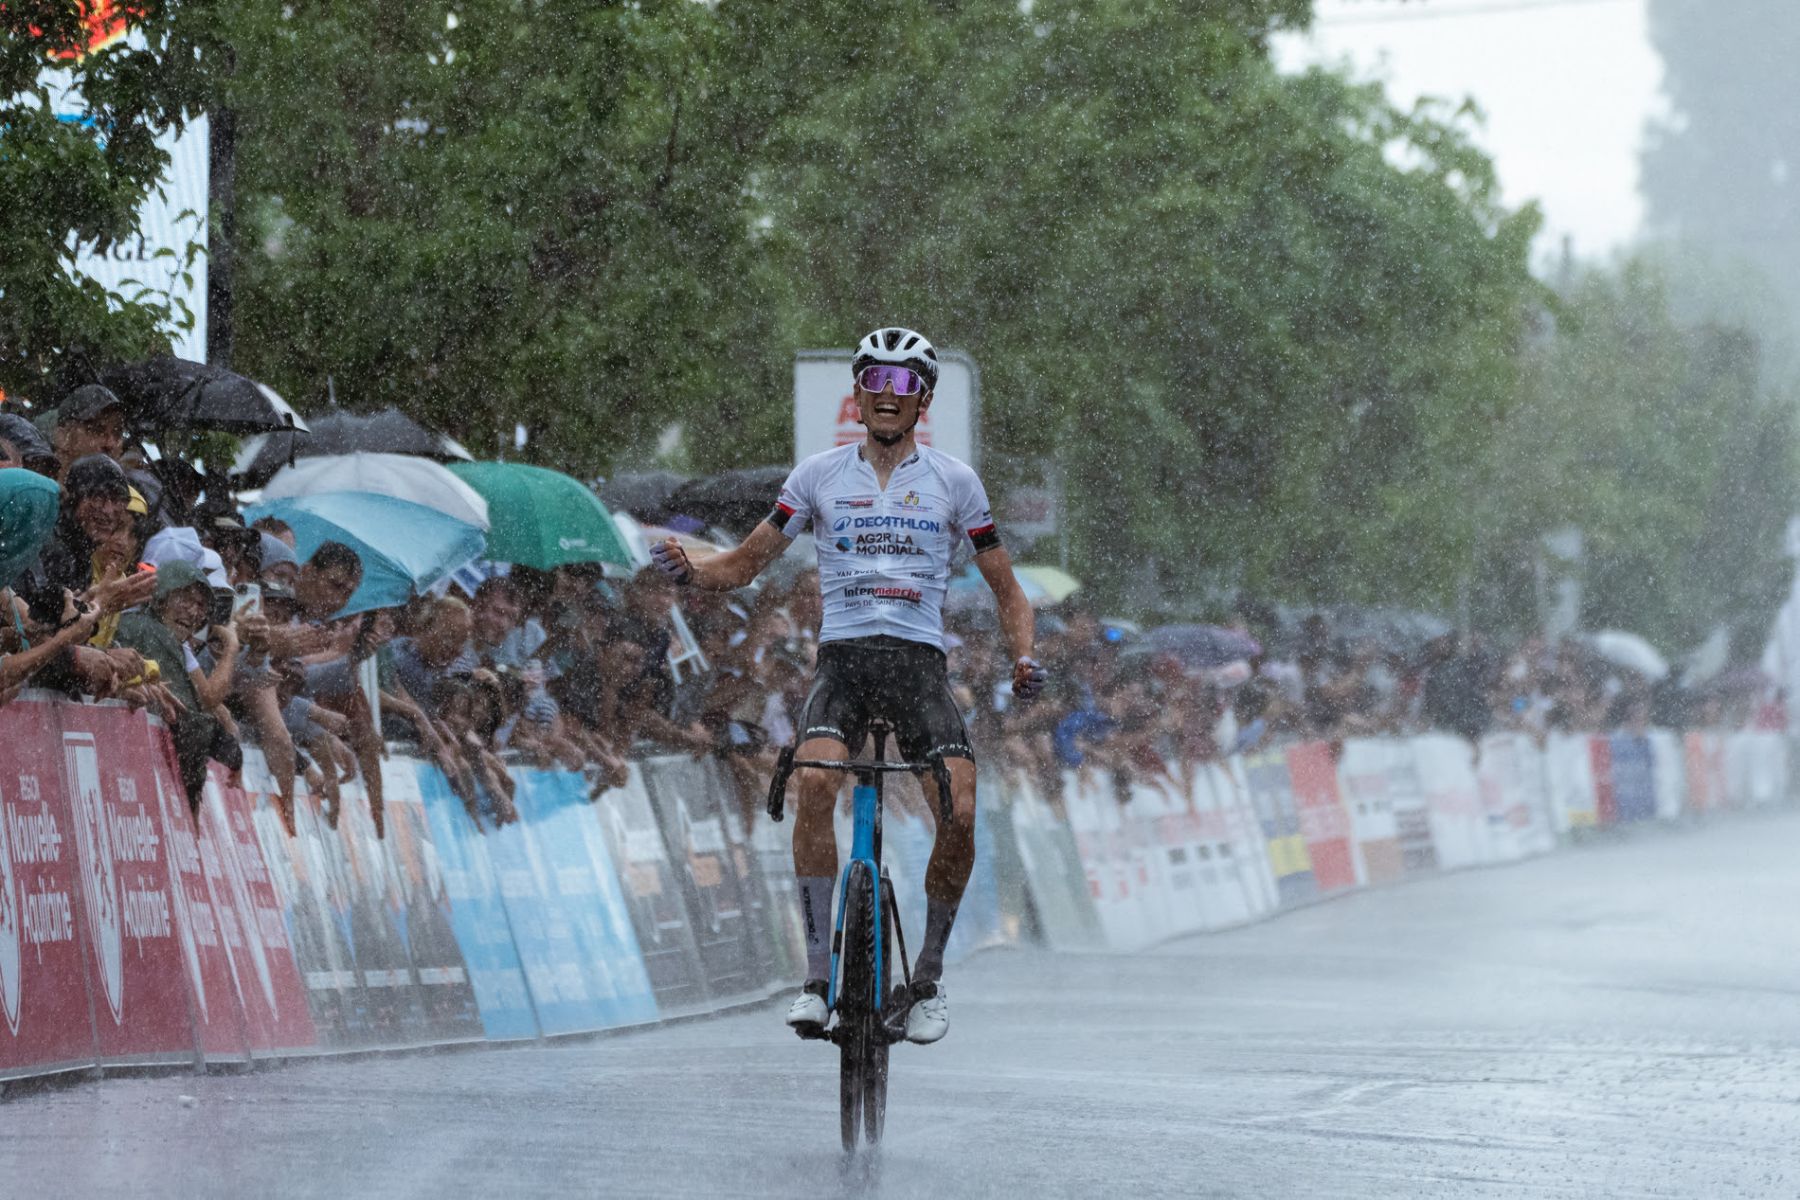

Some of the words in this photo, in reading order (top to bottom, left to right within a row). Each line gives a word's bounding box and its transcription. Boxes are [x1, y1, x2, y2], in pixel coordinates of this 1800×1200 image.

[854, 516, 940, 533] DECATHLON
[856, 532, 891, 544] AG2R
[896, 533, 914, 545] LA
[856, 544, 925, 556] MONDIALE
[844, 586, 922, 600] Intermarché
[21, 874, 73, 965] Aquitaine
[120, 873, 171, 959] Aquitaine
